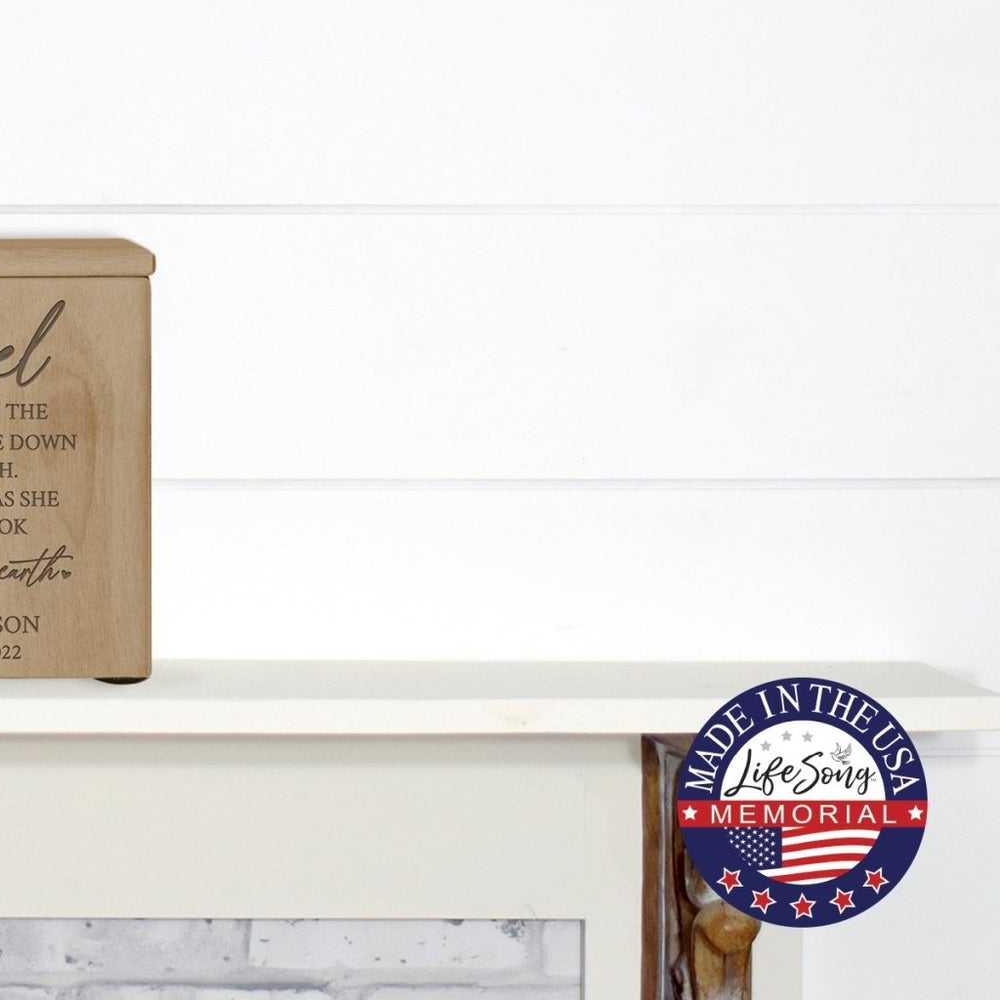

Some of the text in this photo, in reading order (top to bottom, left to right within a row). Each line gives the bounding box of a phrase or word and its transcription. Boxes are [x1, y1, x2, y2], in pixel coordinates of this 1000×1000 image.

[5, 403, 48, 420] THE
[9, 434, 77, 451] DOWN
[19, 490, 60, 508] SHE
